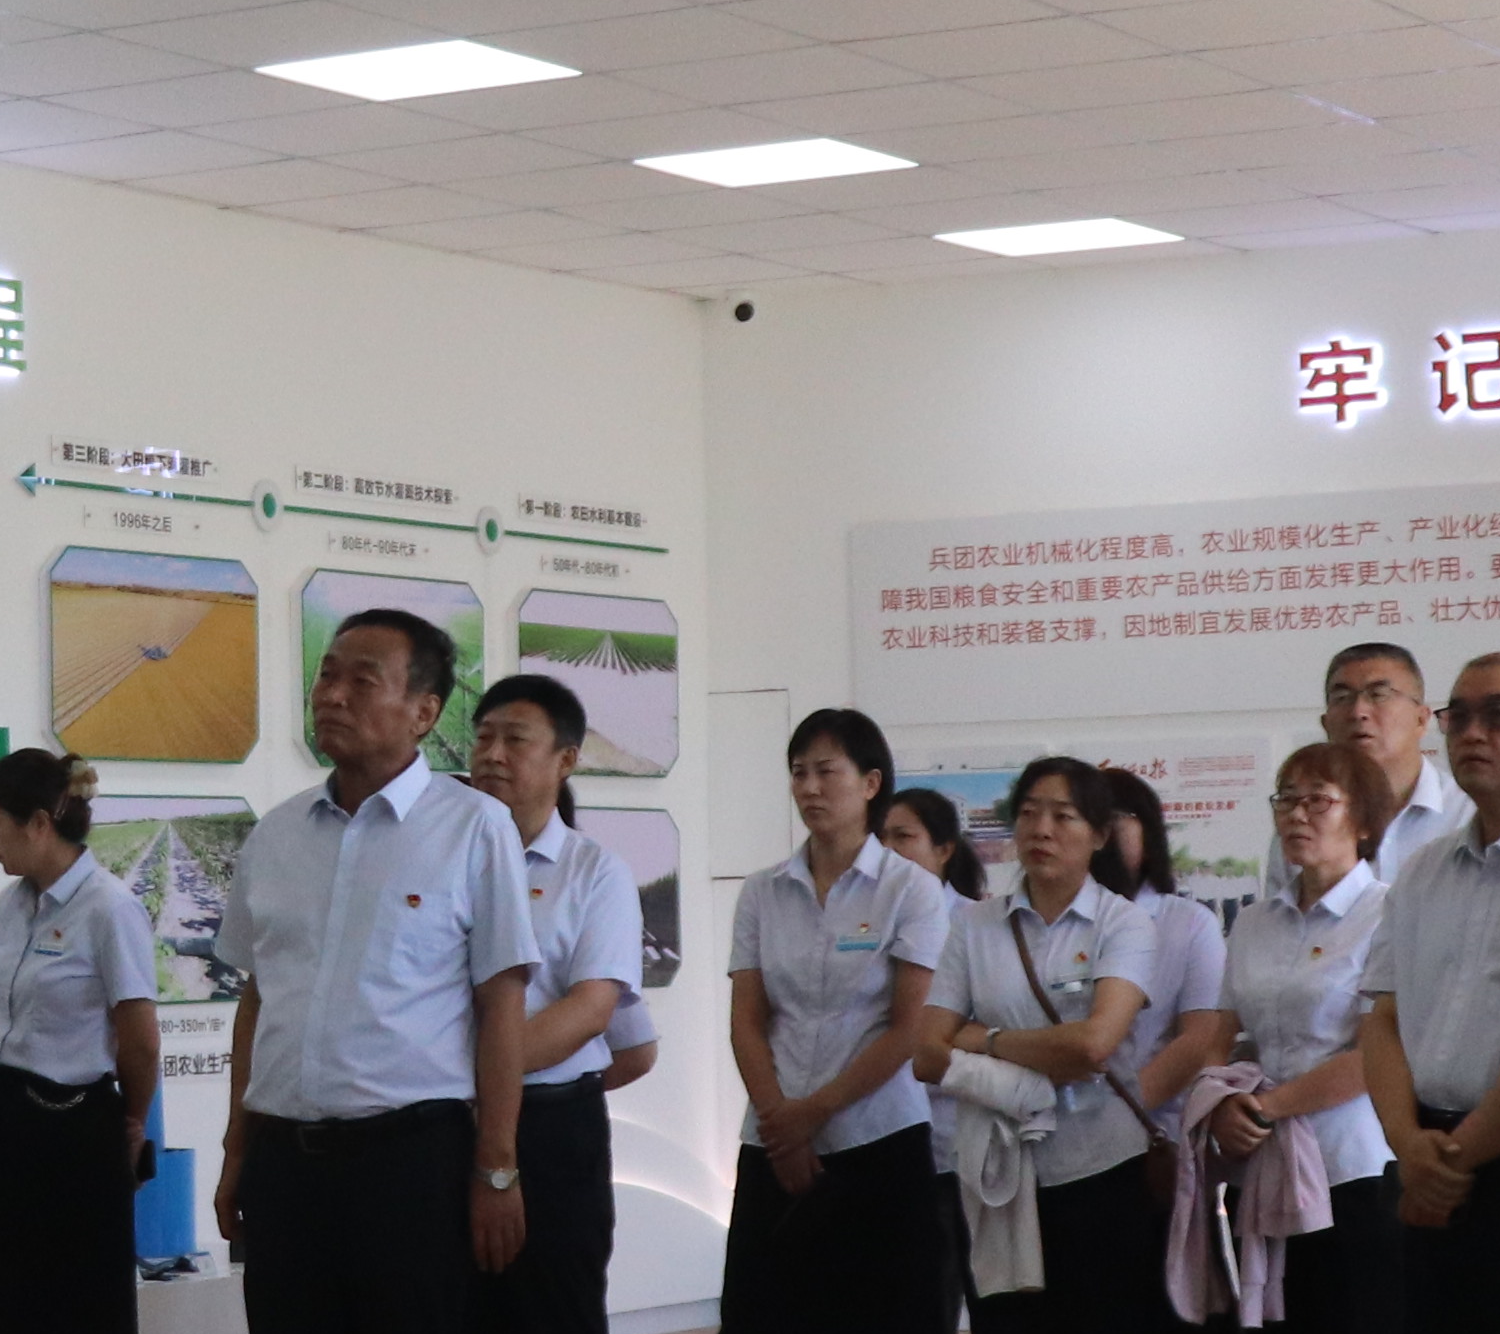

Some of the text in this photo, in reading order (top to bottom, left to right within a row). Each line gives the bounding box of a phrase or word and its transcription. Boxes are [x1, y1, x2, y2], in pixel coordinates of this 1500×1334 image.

[113, 511, 172, 533] 1996年之后
[161, 1053, 232, 1078] 团农业生产
